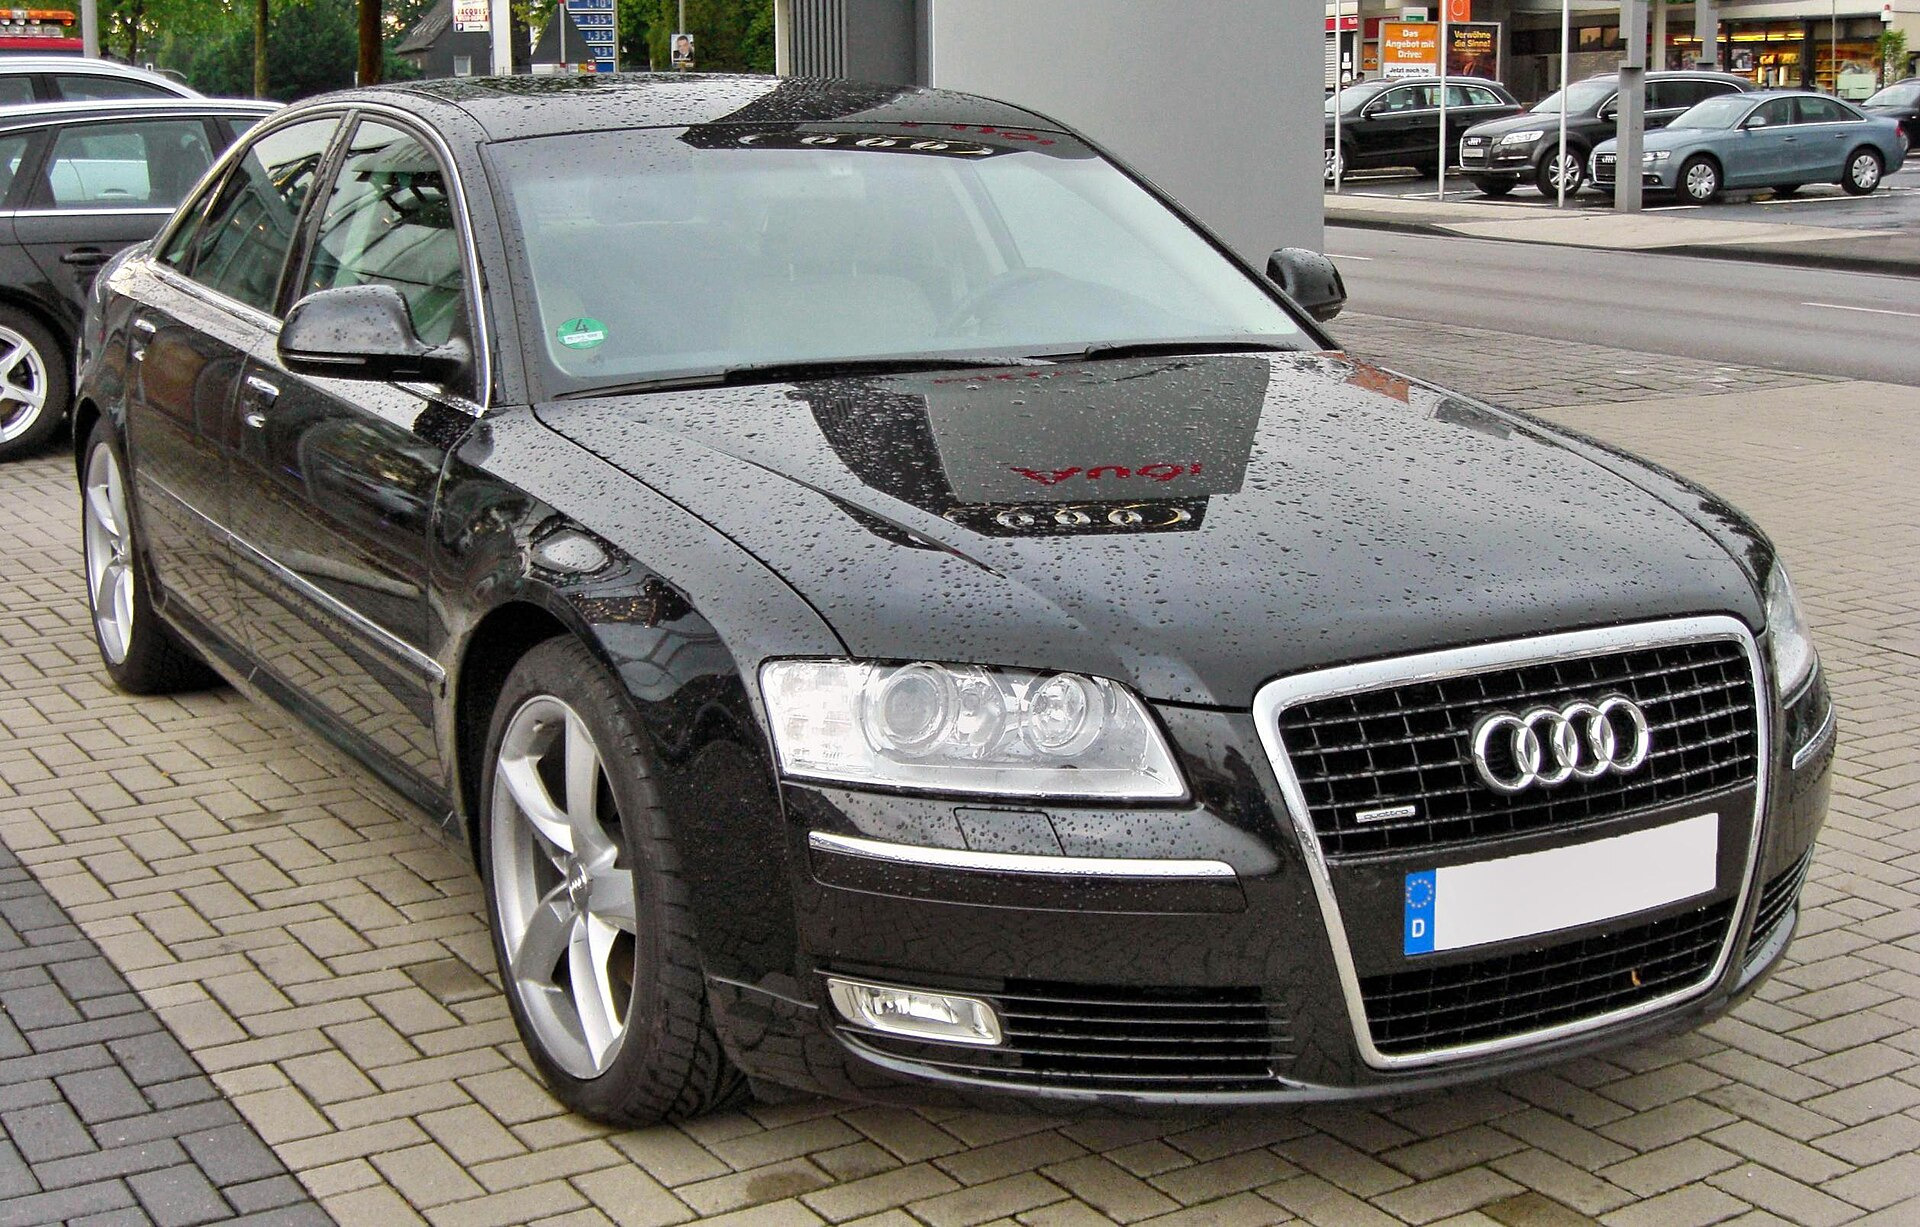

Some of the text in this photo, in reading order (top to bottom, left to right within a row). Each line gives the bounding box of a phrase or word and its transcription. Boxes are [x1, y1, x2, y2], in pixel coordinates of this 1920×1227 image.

[1402, 29, 1419, 38] Das
[1385, 40, 1435, 50] Angebot mit
[575, 318, 589, 332] 4
[1363, 808, 1410, 820] quattro
[1411, 918, 1426, 939] D
